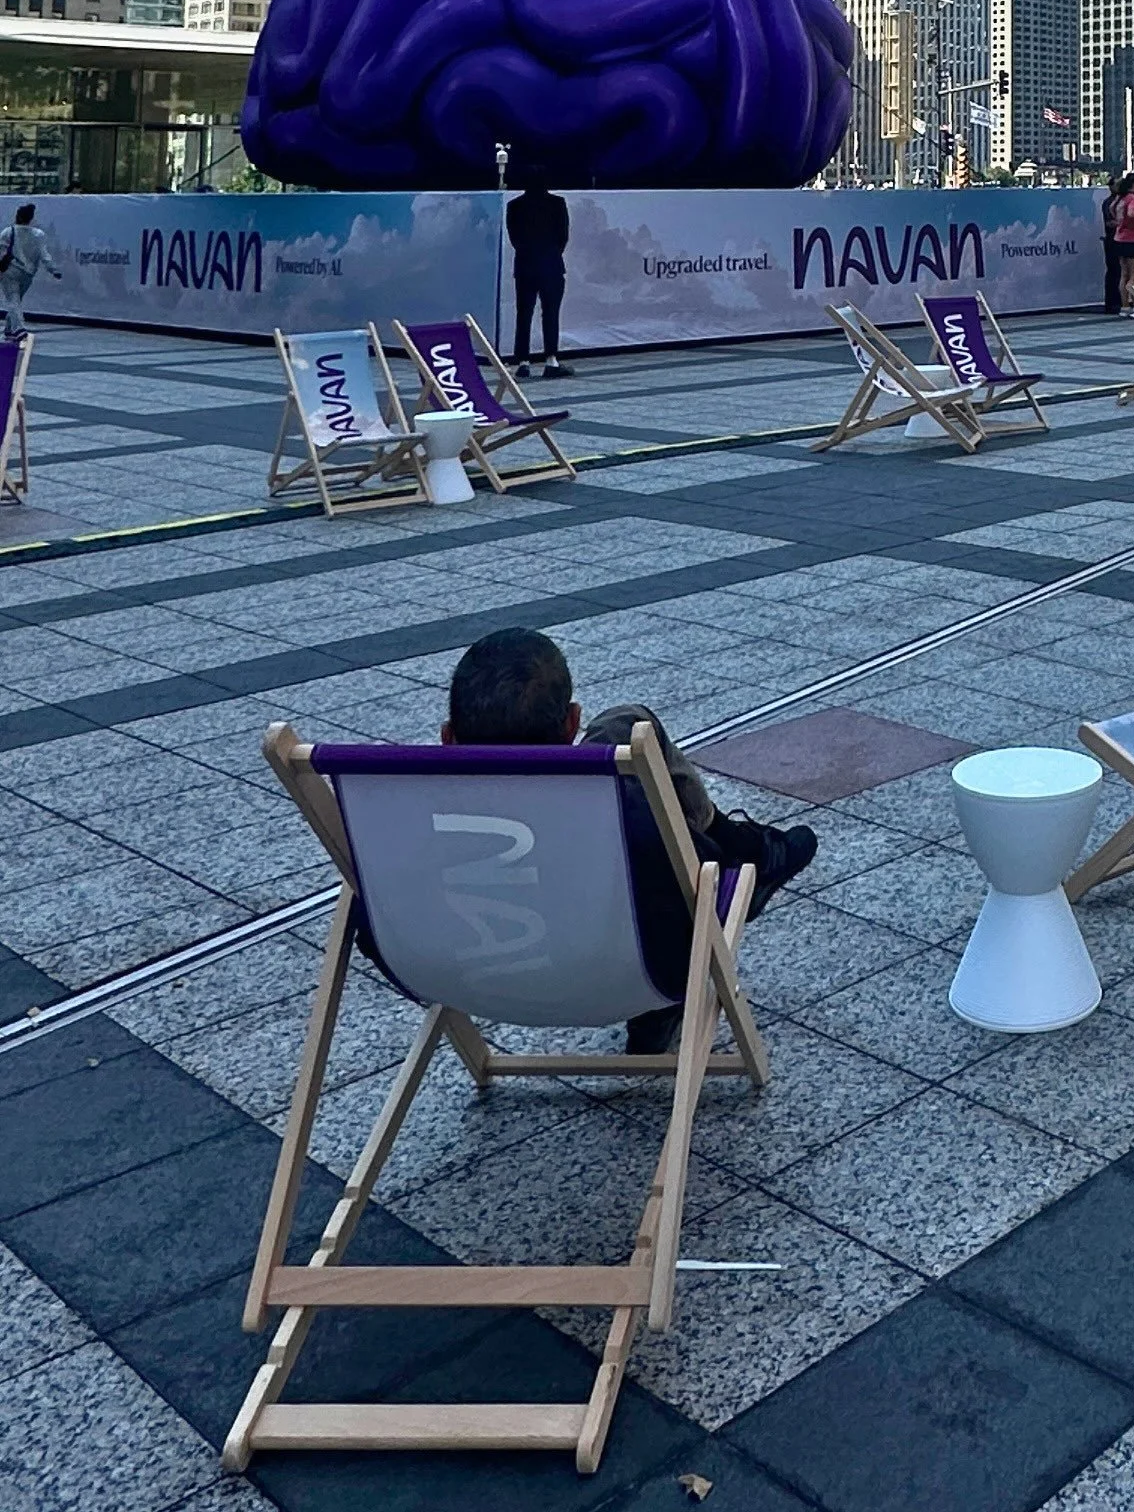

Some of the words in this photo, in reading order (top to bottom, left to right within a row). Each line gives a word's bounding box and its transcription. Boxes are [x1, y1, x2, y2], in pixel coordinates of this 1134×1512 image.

[1001, 240, 1047, 259] Powered
[643, 255, 723, 279] Upgraded
[725, 252, 772, 272] travel.
